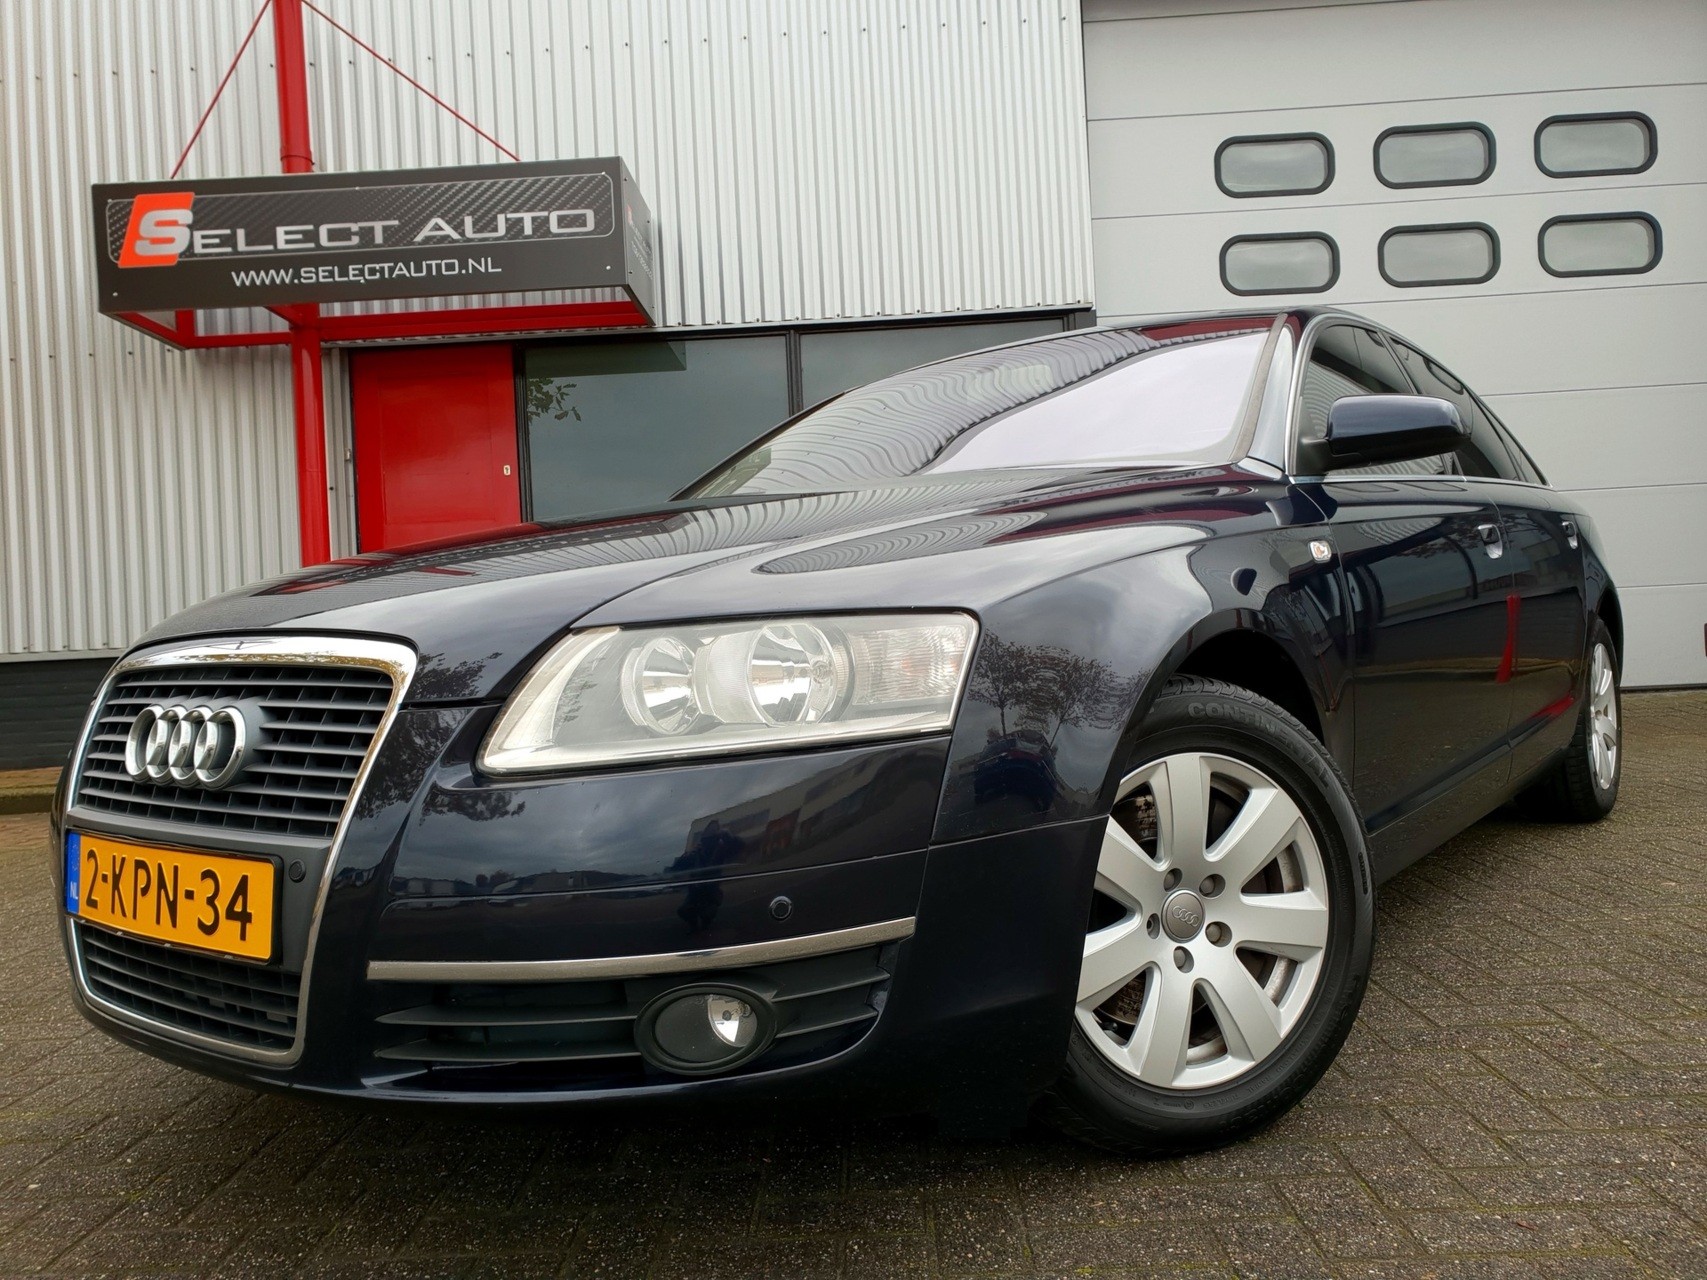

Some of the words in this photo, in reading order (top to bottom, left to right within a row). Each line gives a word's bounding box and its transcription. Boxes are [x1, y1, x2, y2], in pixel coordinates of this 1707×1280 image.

[133, 208, 400, 256] SELECT
[413, 208, 595, 242] AUTO
[231, 256, 502, 287] WWW.SELECTAUTO.NL
[70, 881, 79, 900] NL
[86, 848, 253, 941] 2-KPN-34
